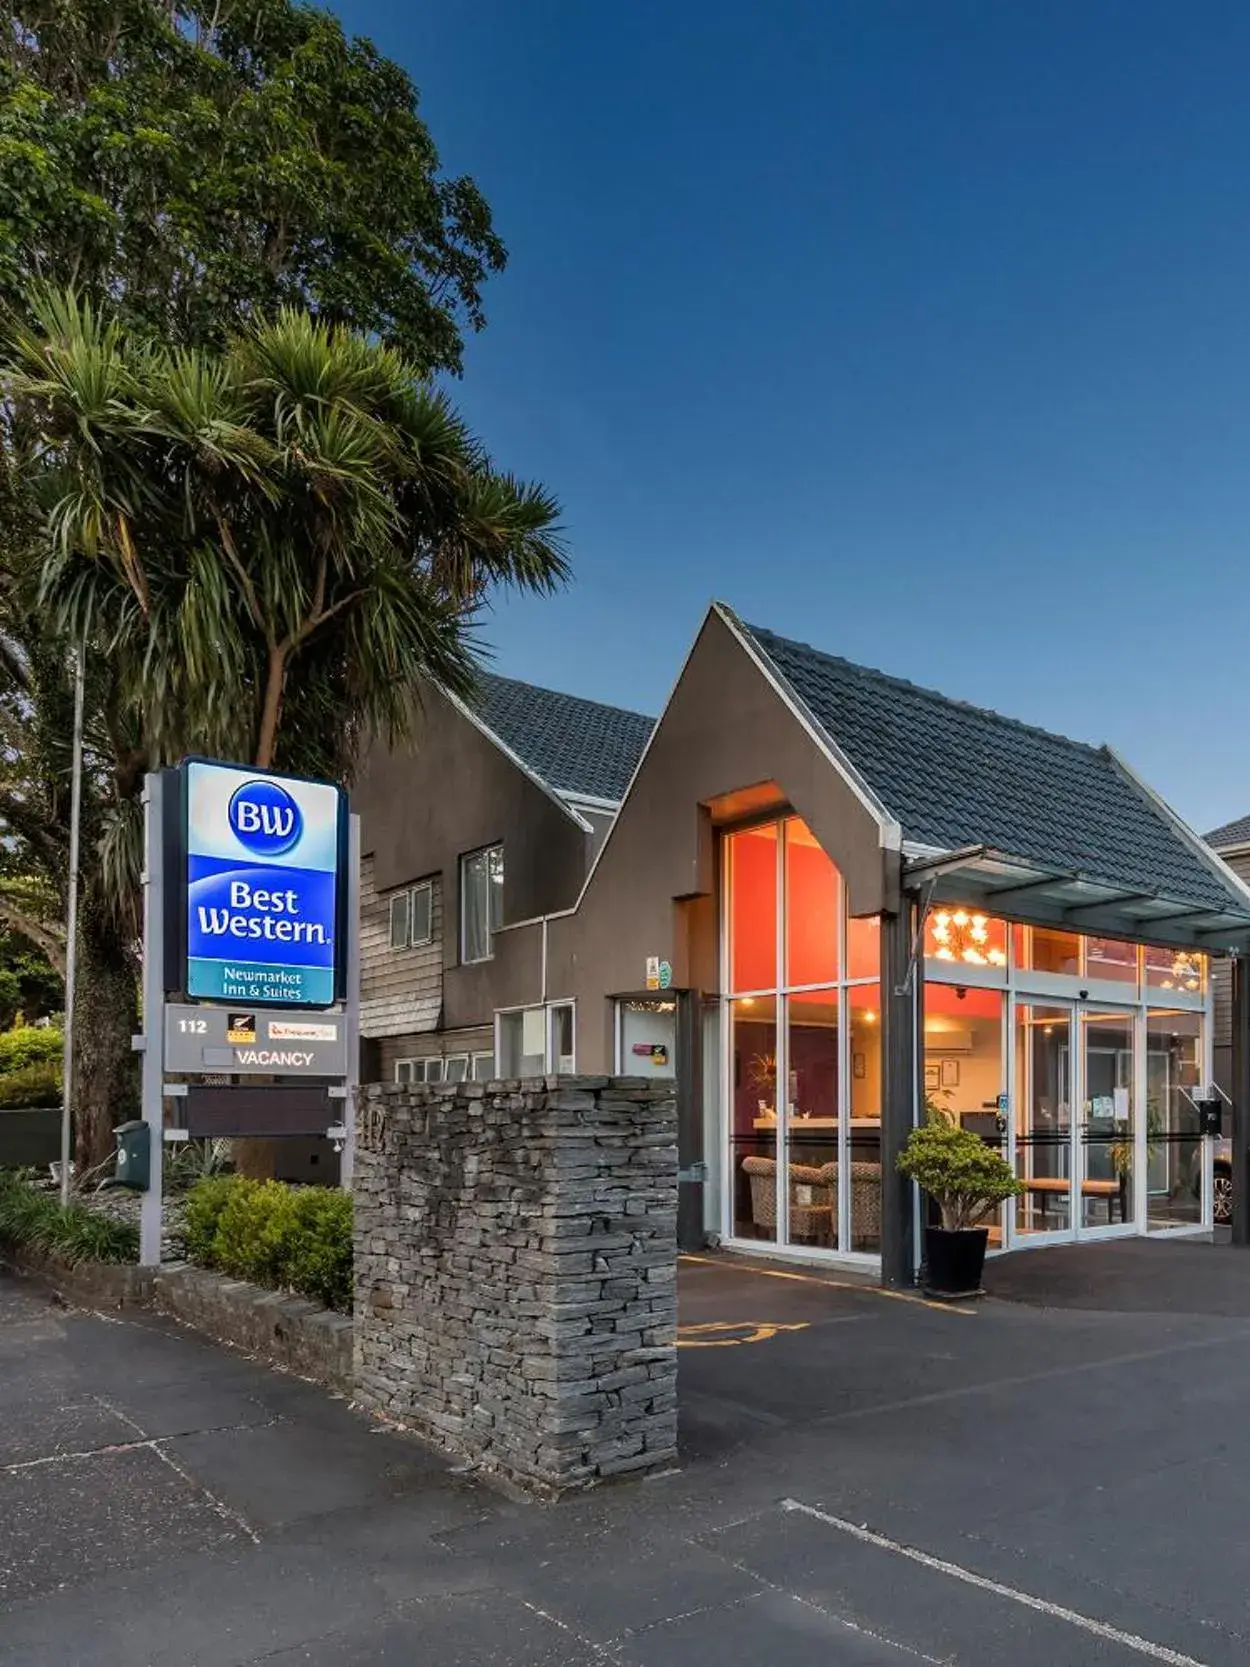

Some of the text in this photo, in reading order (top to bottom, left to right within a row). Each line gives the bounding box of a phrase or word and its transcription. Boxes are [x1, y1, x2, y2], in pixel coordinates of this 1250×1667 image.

[238, 801, 294, 836] BW
[231, 880, 299, 914] Best
[223, 967, 303, 985] Newmarket
[223, 982, 301, 999] Inn & Suites
[177, 1020, 208, 1033] 112
[236, 1050, 314, 1066] VACANCY
